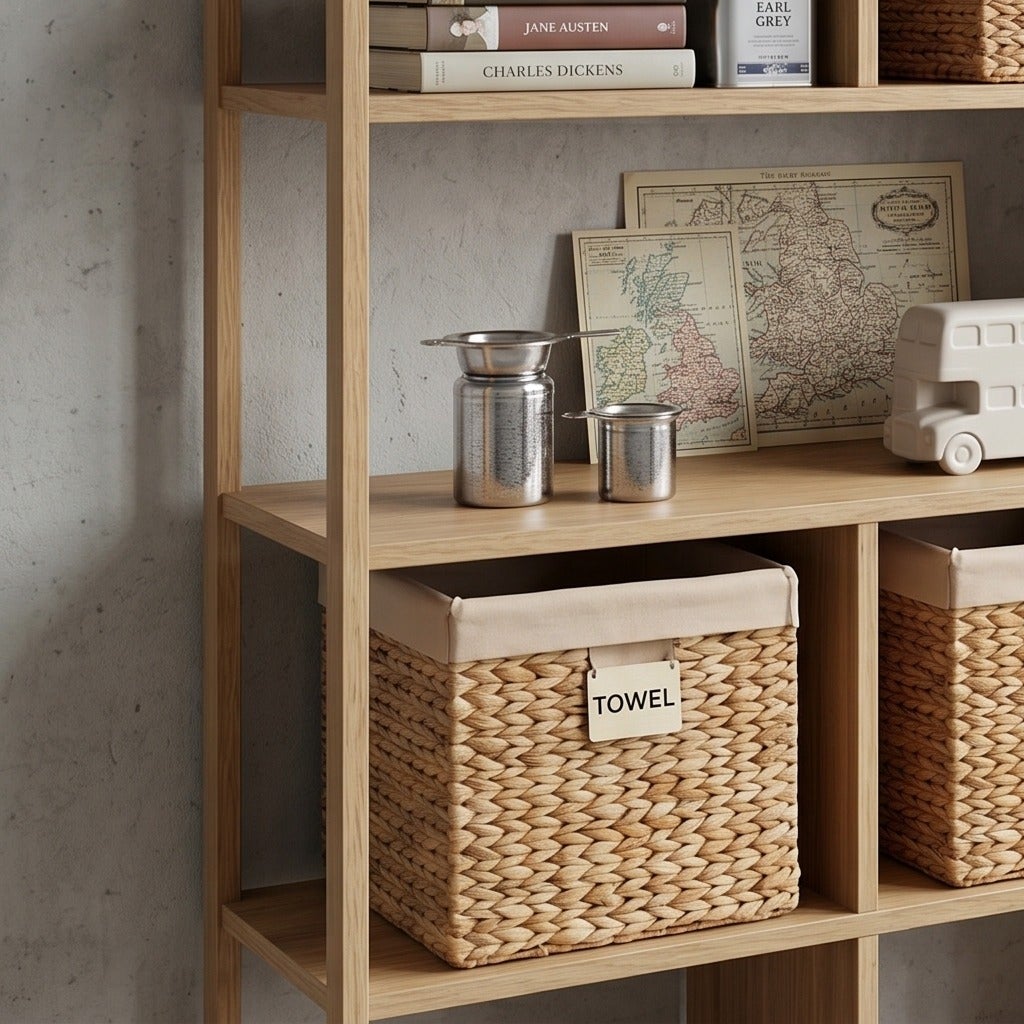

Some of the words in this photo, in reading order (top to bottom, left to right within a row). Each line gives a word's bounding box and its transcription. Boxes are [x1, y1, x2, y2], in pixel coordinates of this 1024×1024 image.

[757, 2, 792, 13] EARL
[756, 15, 792, 27] GREY
[524, 22, 556, 36] JANE
[559, 22, 609, 33] AUSTEN
[483, 65, 552, 78] CHARLES
[557, 64, 624, 77] DICKENS
[592, 687, 676, 715] TOWEL
